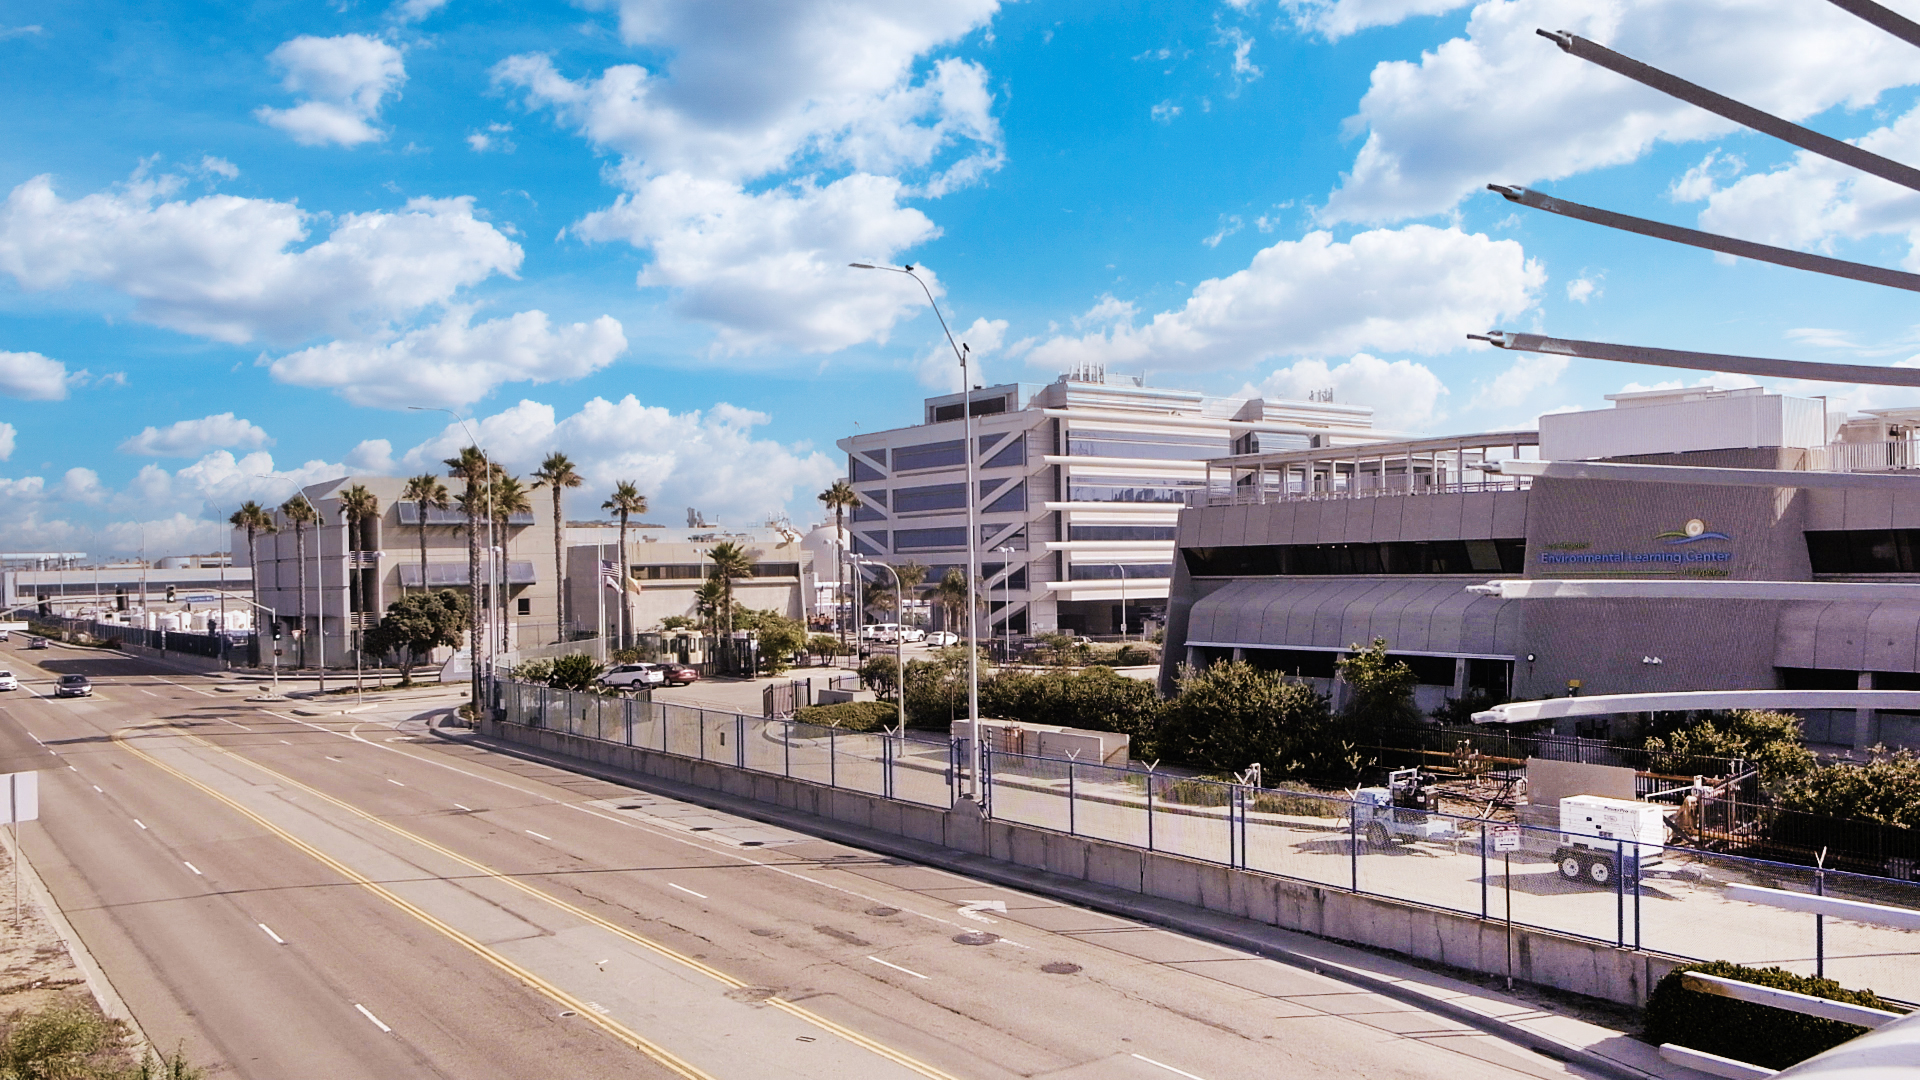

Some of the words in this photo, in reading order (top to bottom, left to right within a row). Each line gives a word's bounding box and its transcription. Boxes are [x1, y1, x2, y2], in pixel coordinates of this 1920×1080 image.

[1541, 552, 1624, 563] Environmental
[1629, 552, 1681, 564] Learning
[1685, 550, 1730, 562] Center
